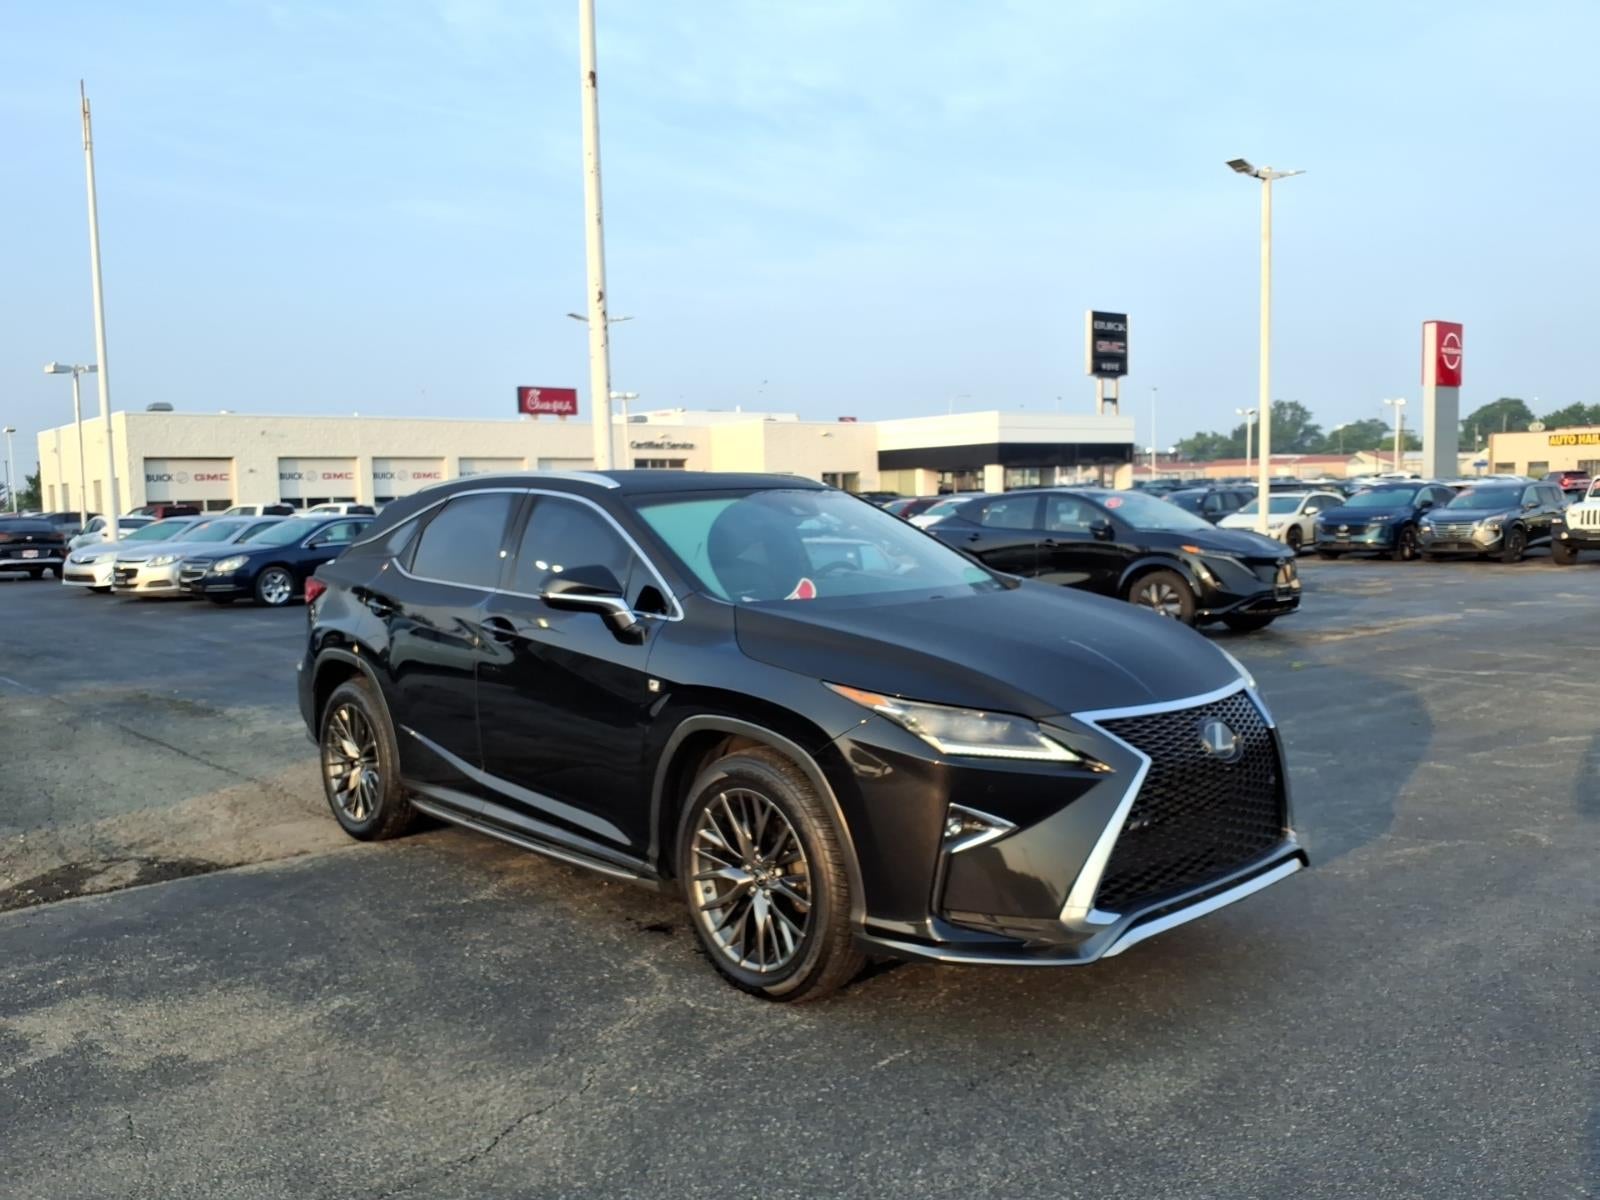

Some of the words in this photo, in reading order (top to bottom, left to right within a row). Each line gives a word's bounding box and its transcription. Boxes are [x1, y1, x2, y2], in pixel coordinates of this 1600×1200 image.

[1093, 320, 1127, 332] BUICK
[1096, 341, 1126, 353] GMC
[1550, 435, 1577, 446] AUTO
[145, 473, 174, 482] BUICK
[193, 473, 230, 481] GMC
[279, 472, 304, 480] BUICK
[322, 472, 355, 480] GMC
[373, 472, 395, 480] BUICK
[412, 472, 443, 480] GMC
